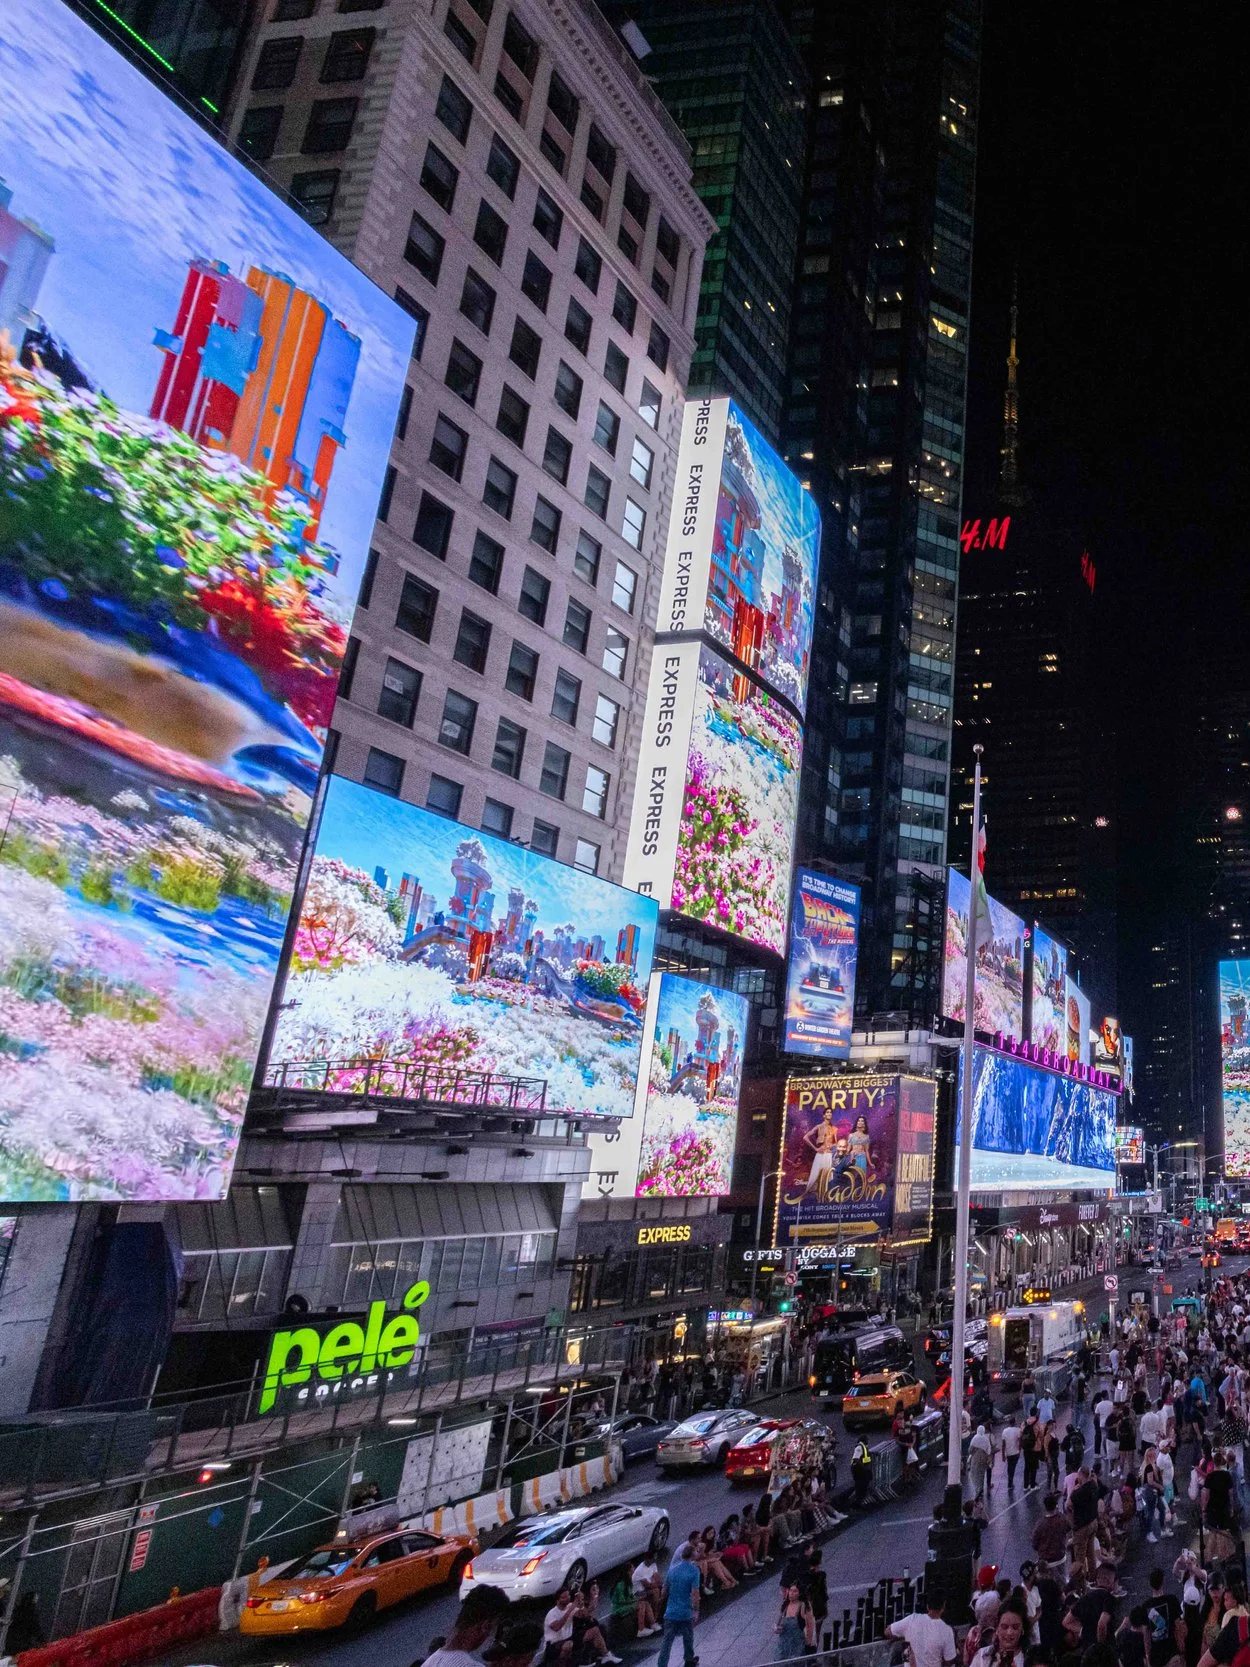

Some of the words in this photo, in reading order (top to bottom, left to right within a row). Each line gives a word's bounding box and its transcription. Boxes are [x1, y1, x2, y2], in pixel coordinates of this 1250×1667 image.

[682, 464, 703, 536] EXPRESS
[960, 516, 1011, 554] H&M
[670, 551, 693, 632] EXPRESS
[655, 656, 680, 747] EXPRESS
[642, 767, 667, 856] EXPRESS
[800, 890, 856, 924] BACK
[790, 1080, 851, 1091] BROADWAY'S
[853, 1078, 895, 1088] BIGGEST
[798, 1088, 886, 1111] PARTY!
[784, 1166, 886, 1205] Aladdin
[816, 1204, 850, 1212] BROADWAY
[638, 1225, 691, 1245] EXPRESS
[743, 1250, 782, 1261] GFTS
[258, 1280, 430, 1415] pelé
